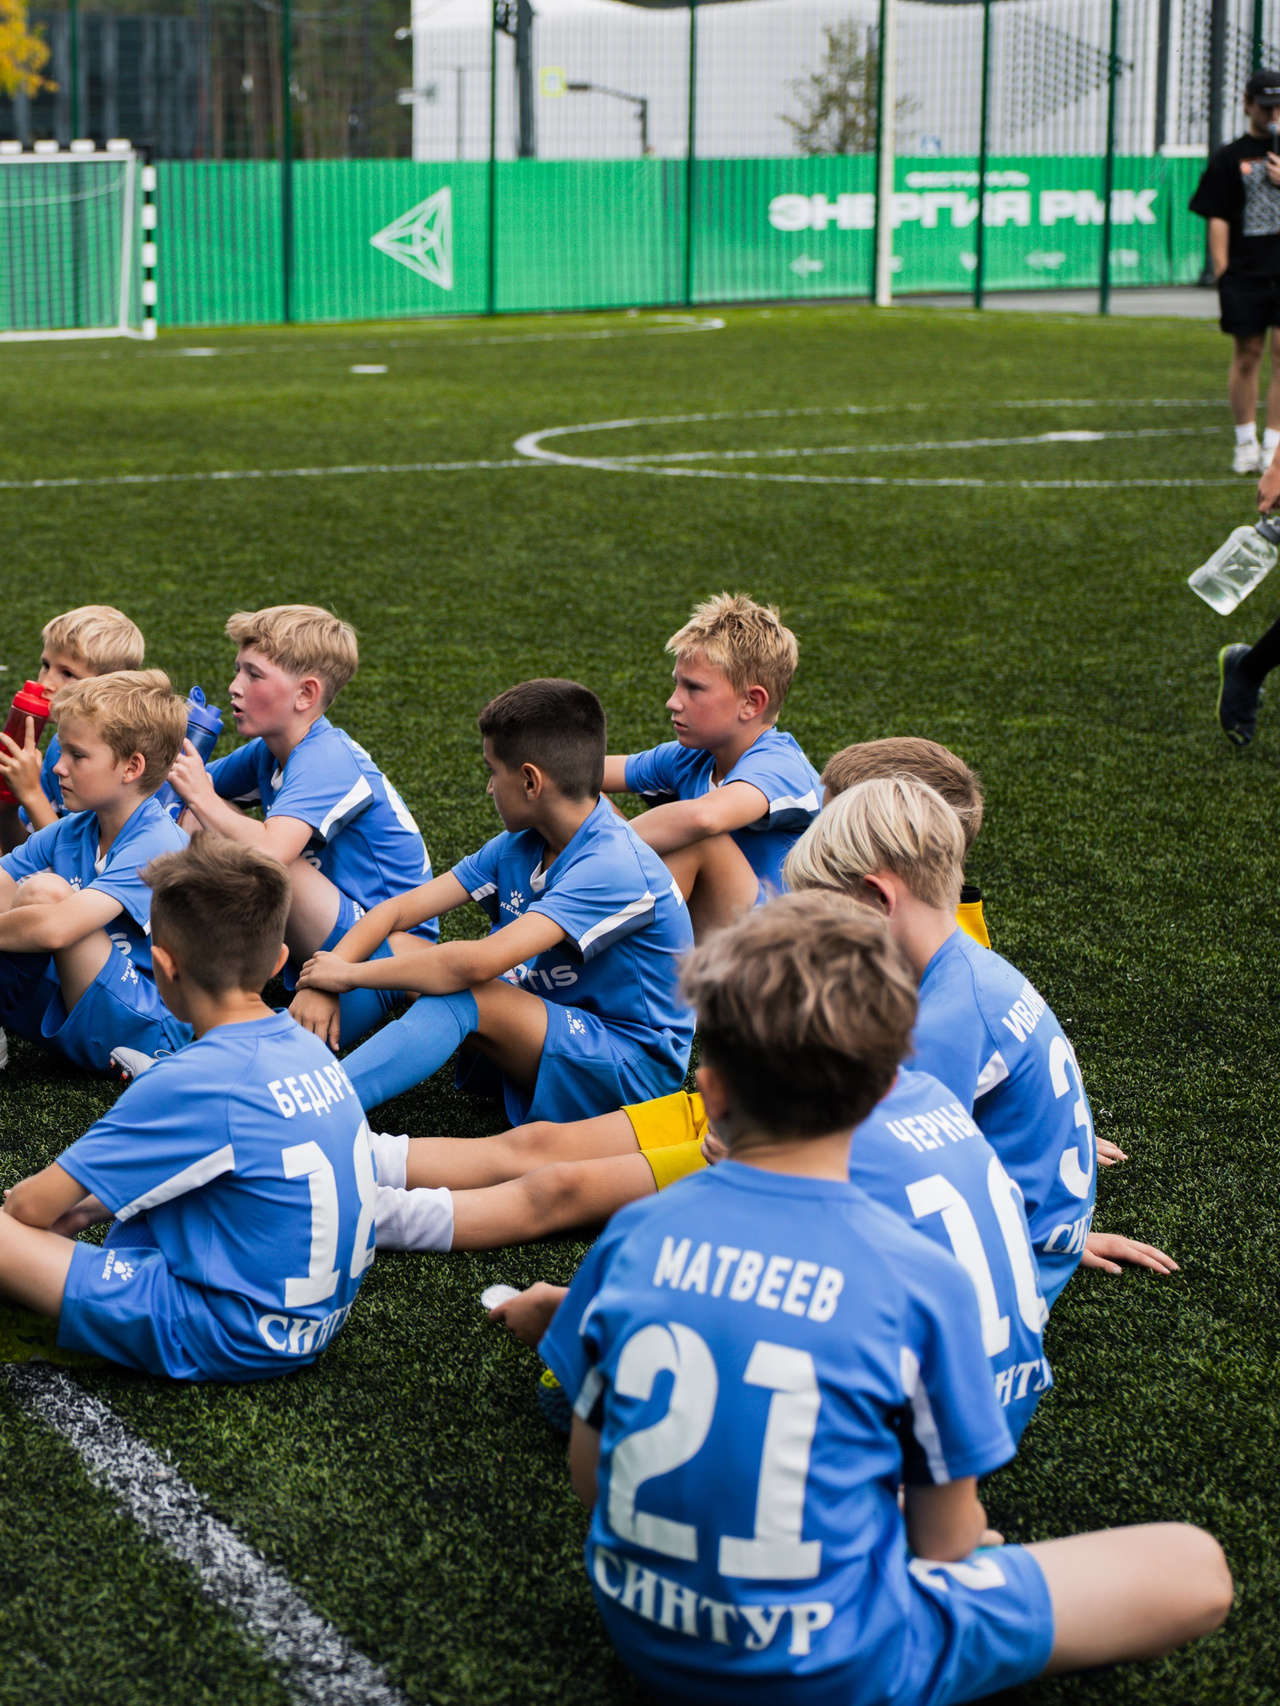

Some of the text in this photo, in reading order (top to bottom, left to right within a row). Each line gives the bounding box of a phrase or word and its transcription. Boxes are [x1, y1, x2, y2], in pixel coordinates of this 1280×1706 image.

[768, 190, 1158, 231] ЭНЕРГИЯ РМК
[885, 1102, 984, 1153] ЧЕРНЫ
[652, 1235, 845, 1323] МАТВЕЕВ
[608, 1322, 821, 1580] 21
[593, 1547, 834, 1655] СИНТУР
